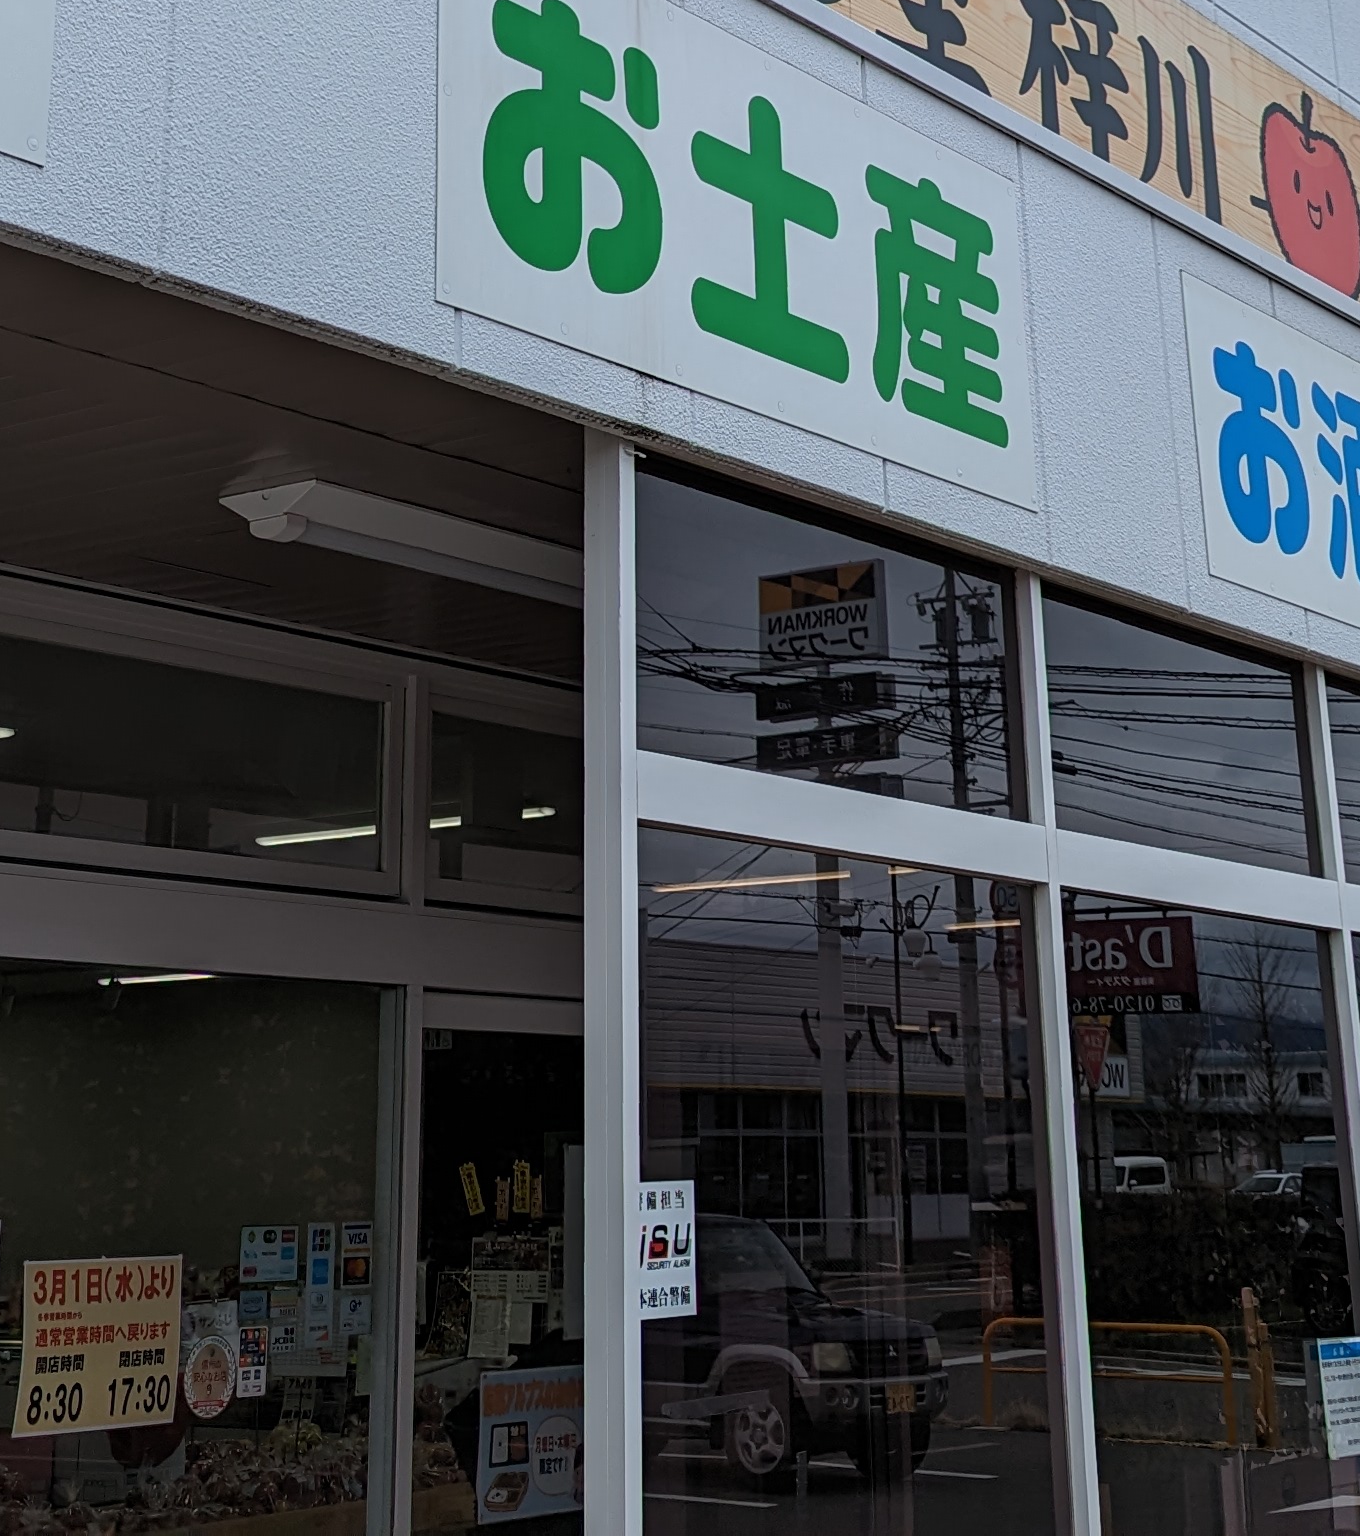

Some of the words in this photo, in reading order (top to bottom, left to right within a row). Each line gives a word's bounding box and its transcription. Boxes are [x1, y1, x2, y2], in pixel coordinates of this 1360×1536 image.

[348, 1232, 368, 1245] VISA
[647, 1260, 672, 1270] SECURITY
[673, 1258, 690, 1268] ALARM
[35, 1321, 171, 1348] 通常営業時間へ戻ります
[35, 1354, 85, 1375] 開店時間
[119, 1348, 166, 1368] 閉店時間
[26, 1382, 83, 1425] 8:30
[108, 1374, 171, 1417] 17:30
